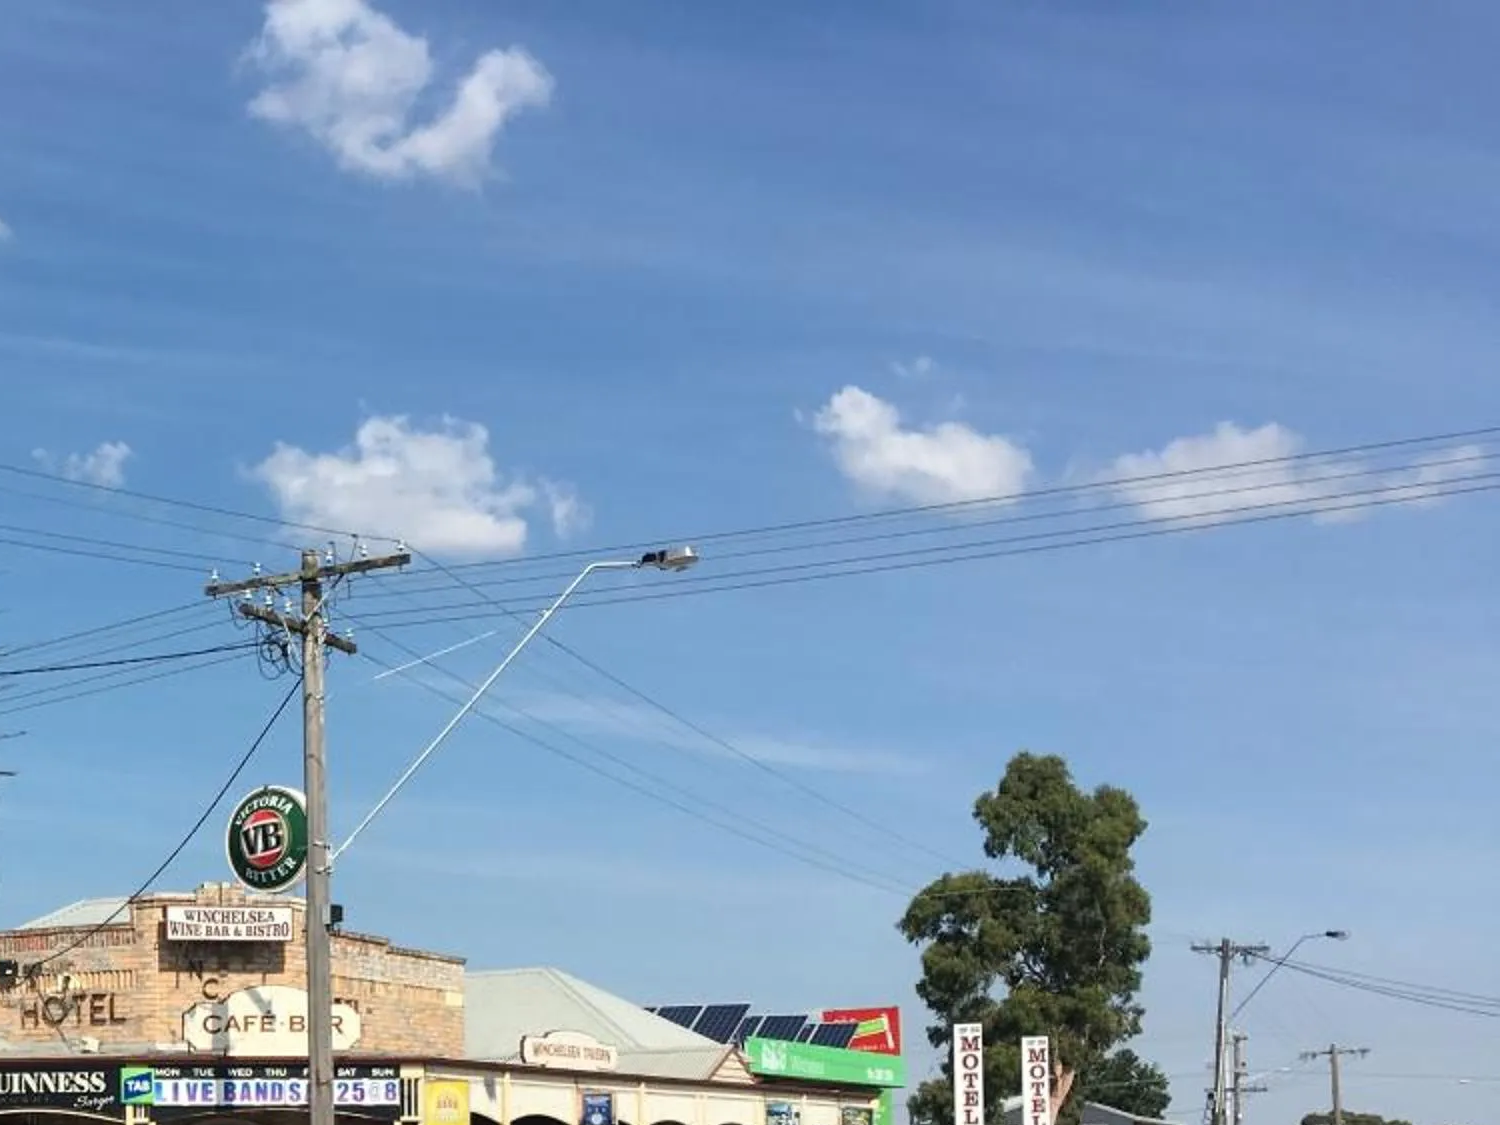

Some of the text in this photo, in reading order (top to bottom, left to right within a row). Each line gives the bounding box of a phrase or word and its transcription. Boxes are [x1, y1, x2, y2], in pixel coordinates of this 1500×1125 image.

[235, 796, 293, 825] VICTORIA
[243, 823, 282, 856] VB
[245, 857, 297, 882] BITTER
[183, 909, 275, 924] WINCHELSEA
[170, 920, 202, 937] WINE
[205, 925, 230, 937] BAR
[245, 921, 290, 937] BISTRO
[20, 992, 127, 1030] HOTEL
[289, 1015, 345, 1034] BR
[155, 1067, 395, 1077] MON TUE WED THU SAT SUN
[959, 1035, 981, 1125] MOTEL
[125, 1080, 151, 1093] TAB
[154, 1081, 214, 1103] LIVE
[223, 1081, 301, 1103] BANDS
